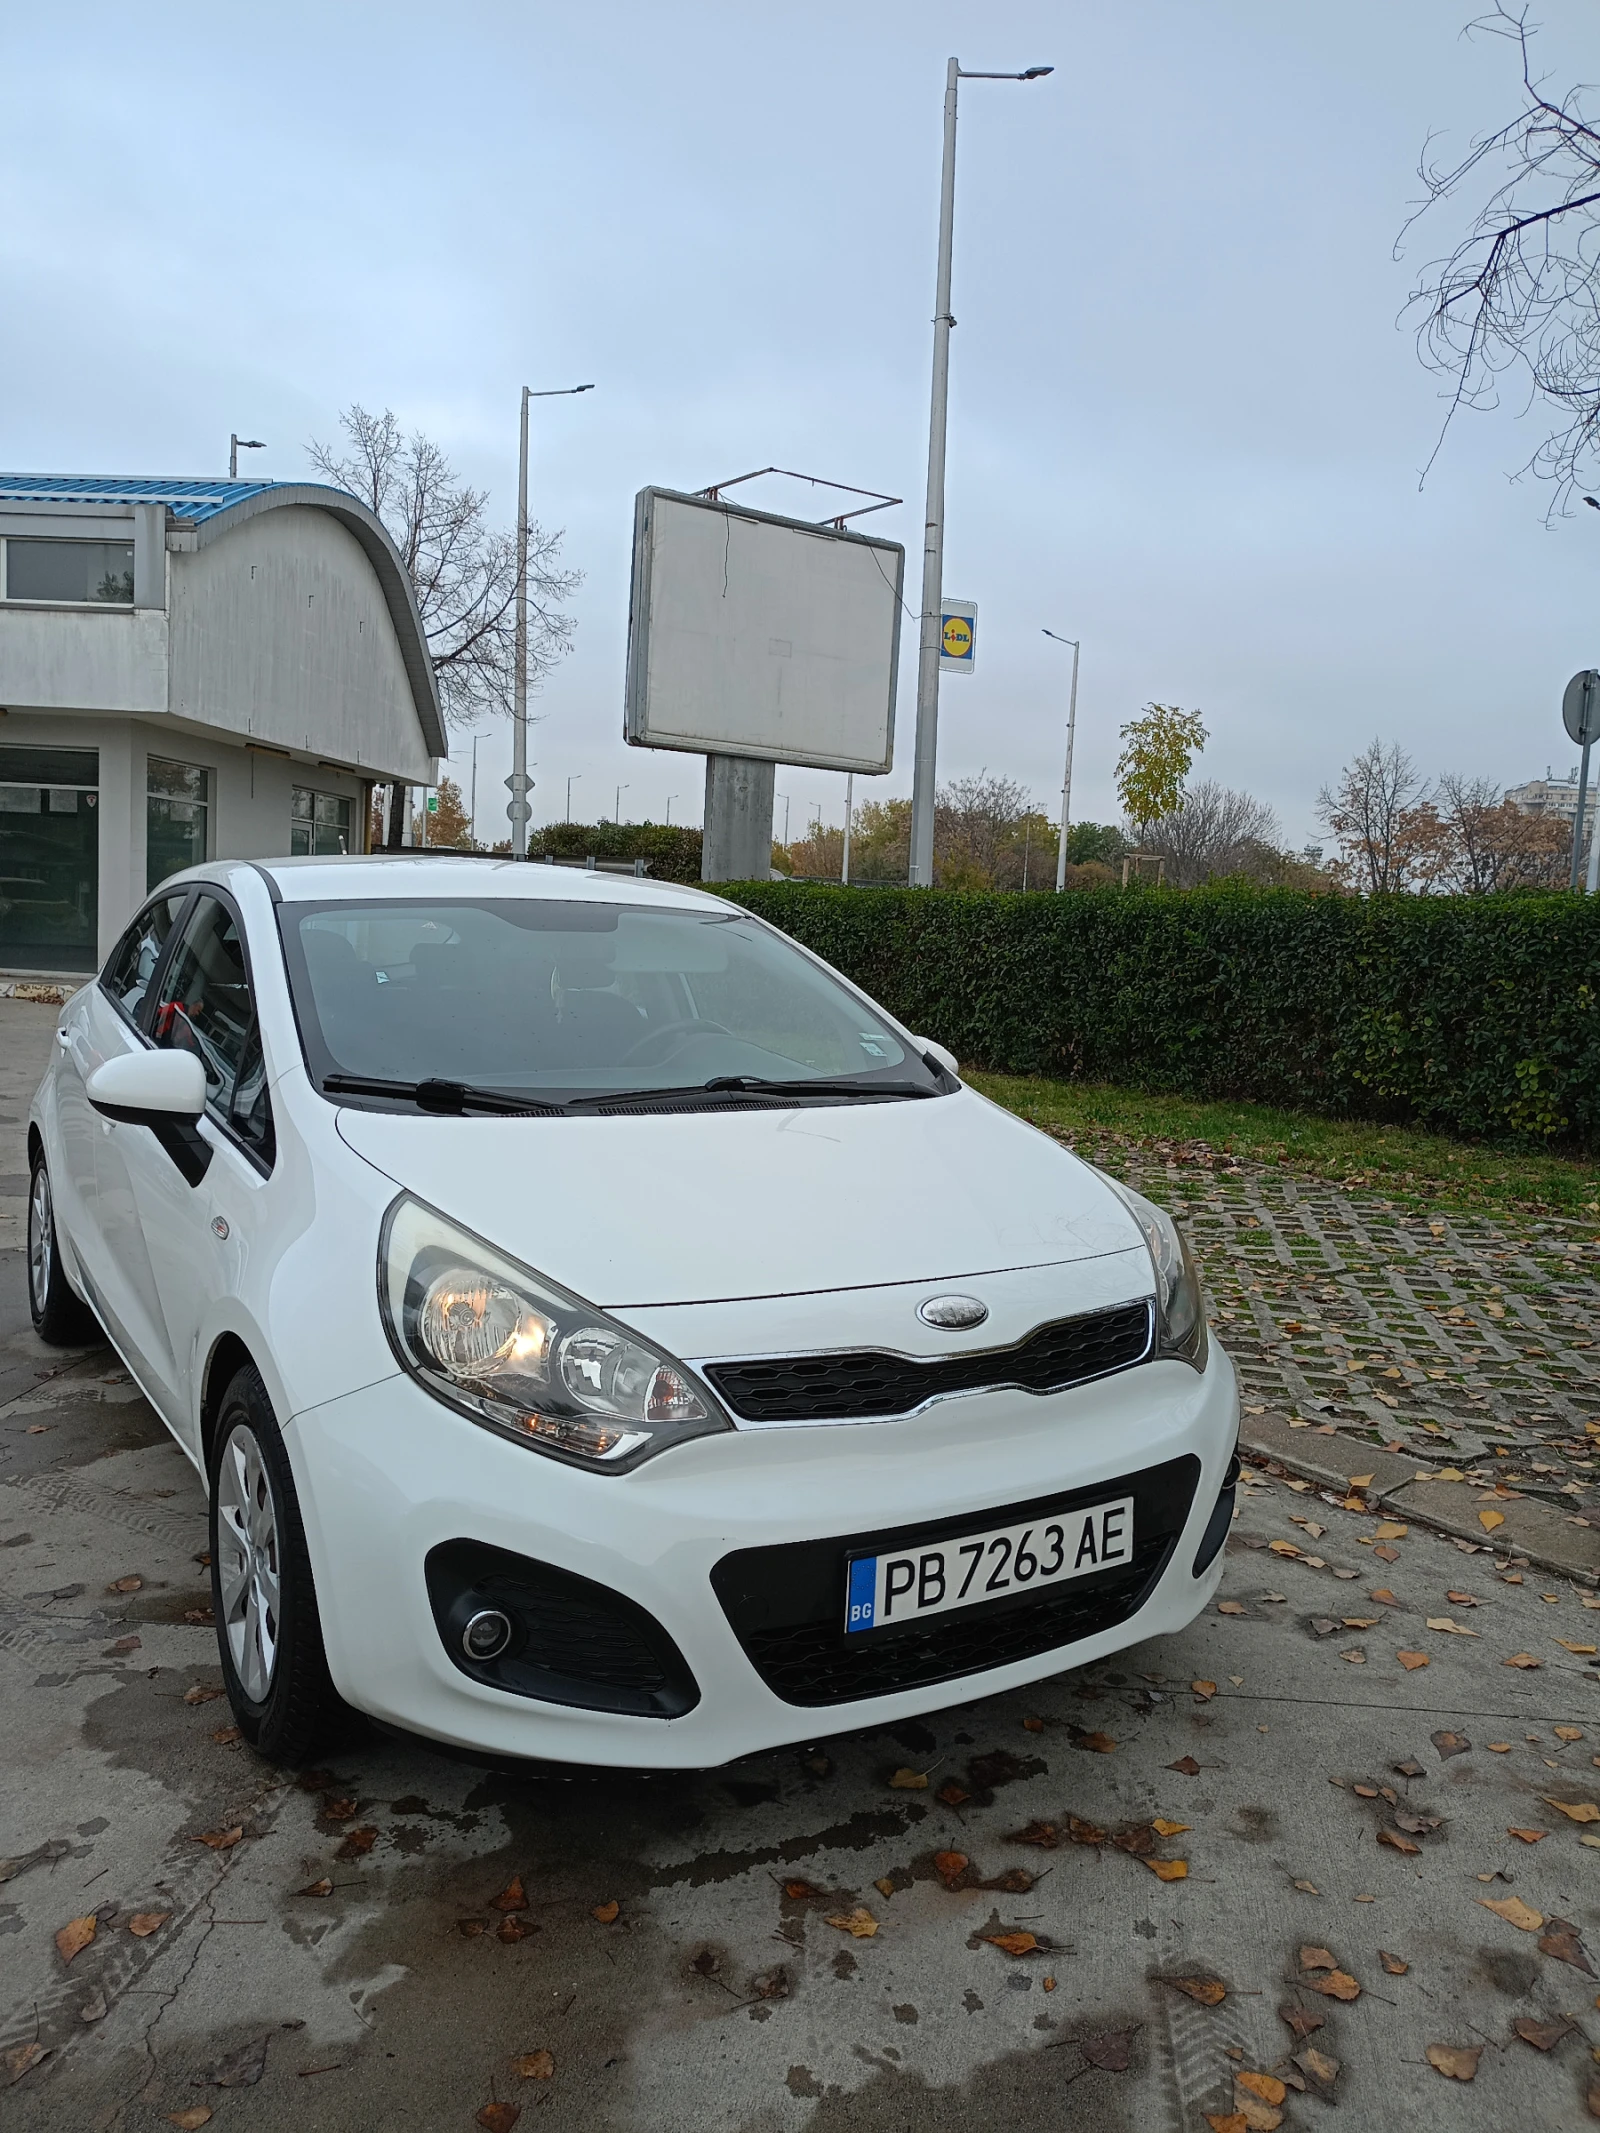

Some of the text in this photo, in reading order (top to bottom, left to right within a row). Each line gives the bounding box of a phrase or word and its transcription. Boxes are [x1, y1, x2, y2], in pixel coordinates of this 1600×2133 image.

[884, 1507, 1126, 1617] PB 7263 AE
[851, 1603, 872, 1622] BG
